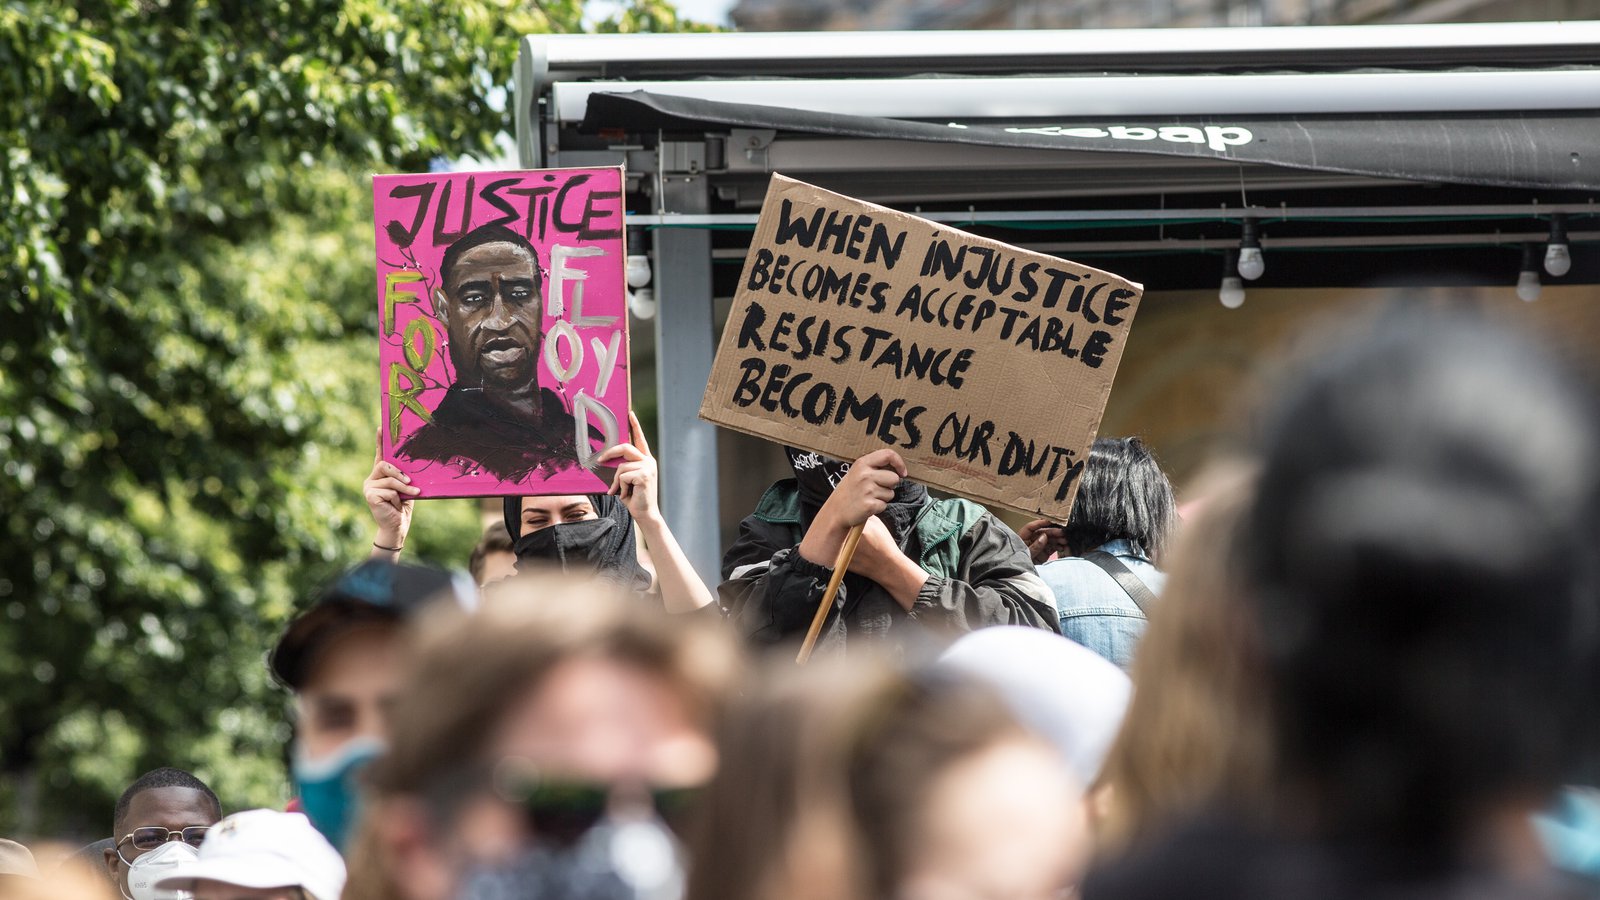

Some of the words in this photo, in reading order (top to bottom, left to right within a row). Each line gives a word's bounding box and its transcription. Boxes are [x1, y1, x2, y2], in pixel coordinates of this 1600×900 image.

[775, 199, 908, 270] WHEN
[383, 272, 435, 447] FOR
[544, 243, 622, 470] FLOYD
[737, 301, 975, 390] RESISTANCE
[748, 248, 893, 314] BECOMES
[895, 283, 1114, 369] ACCEPTABLE
[732, 357, 928, 450] BECOMES
[932, 411, 996, 467] OUR
[998, 431, 1085, 502] DUTY
